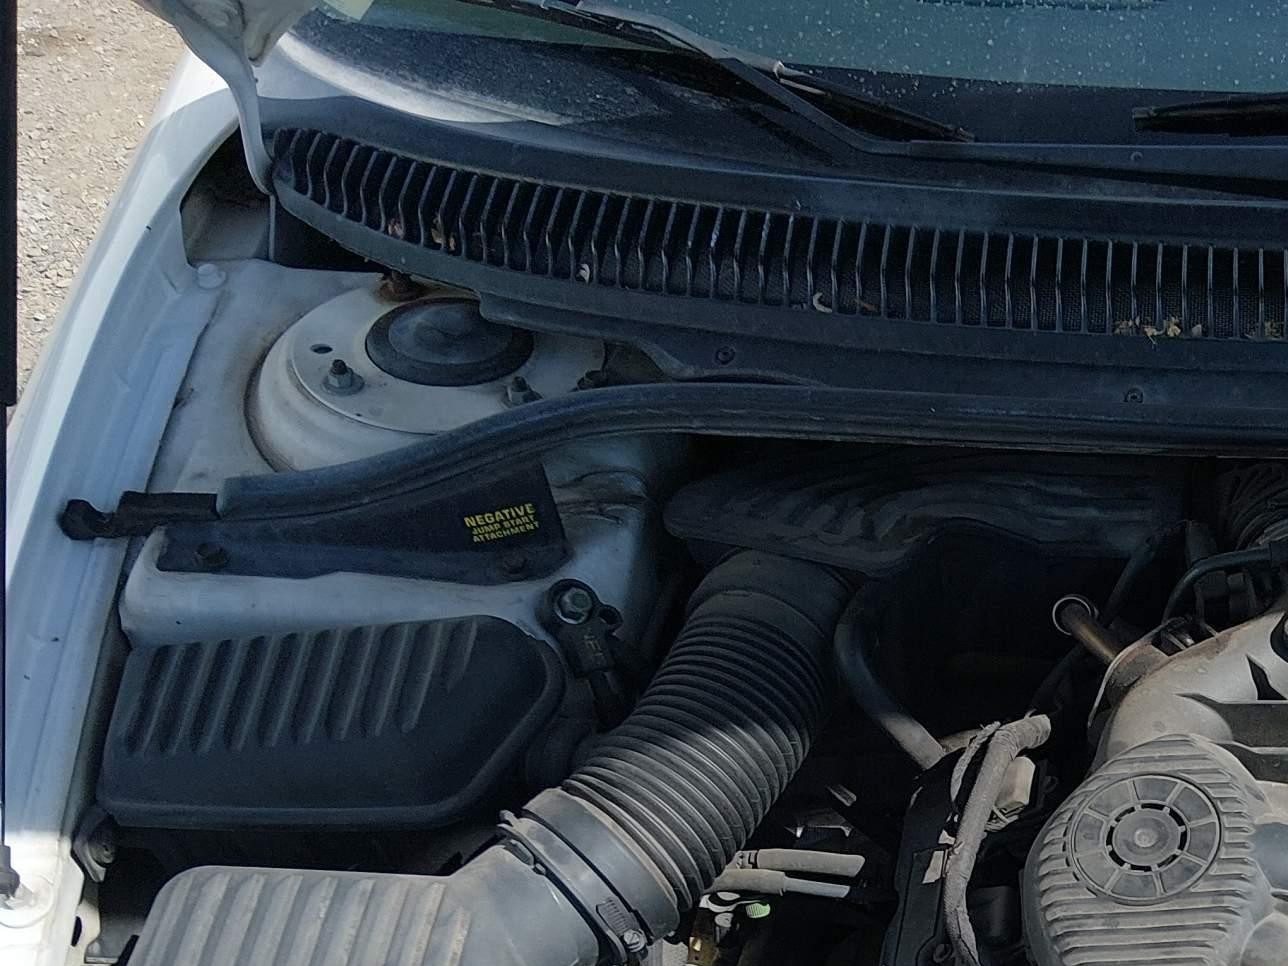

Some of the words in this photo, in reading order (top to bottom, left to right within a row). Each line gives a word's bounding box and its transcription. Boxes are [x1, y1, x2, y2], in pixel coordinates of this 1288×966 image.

[464, 503, 535, 527] NEGATIVE
[472, 523, 501, 535] JUMP
[503, 514, 534, 528] START
[472, 521, 539, 543] ATTACHMENT
